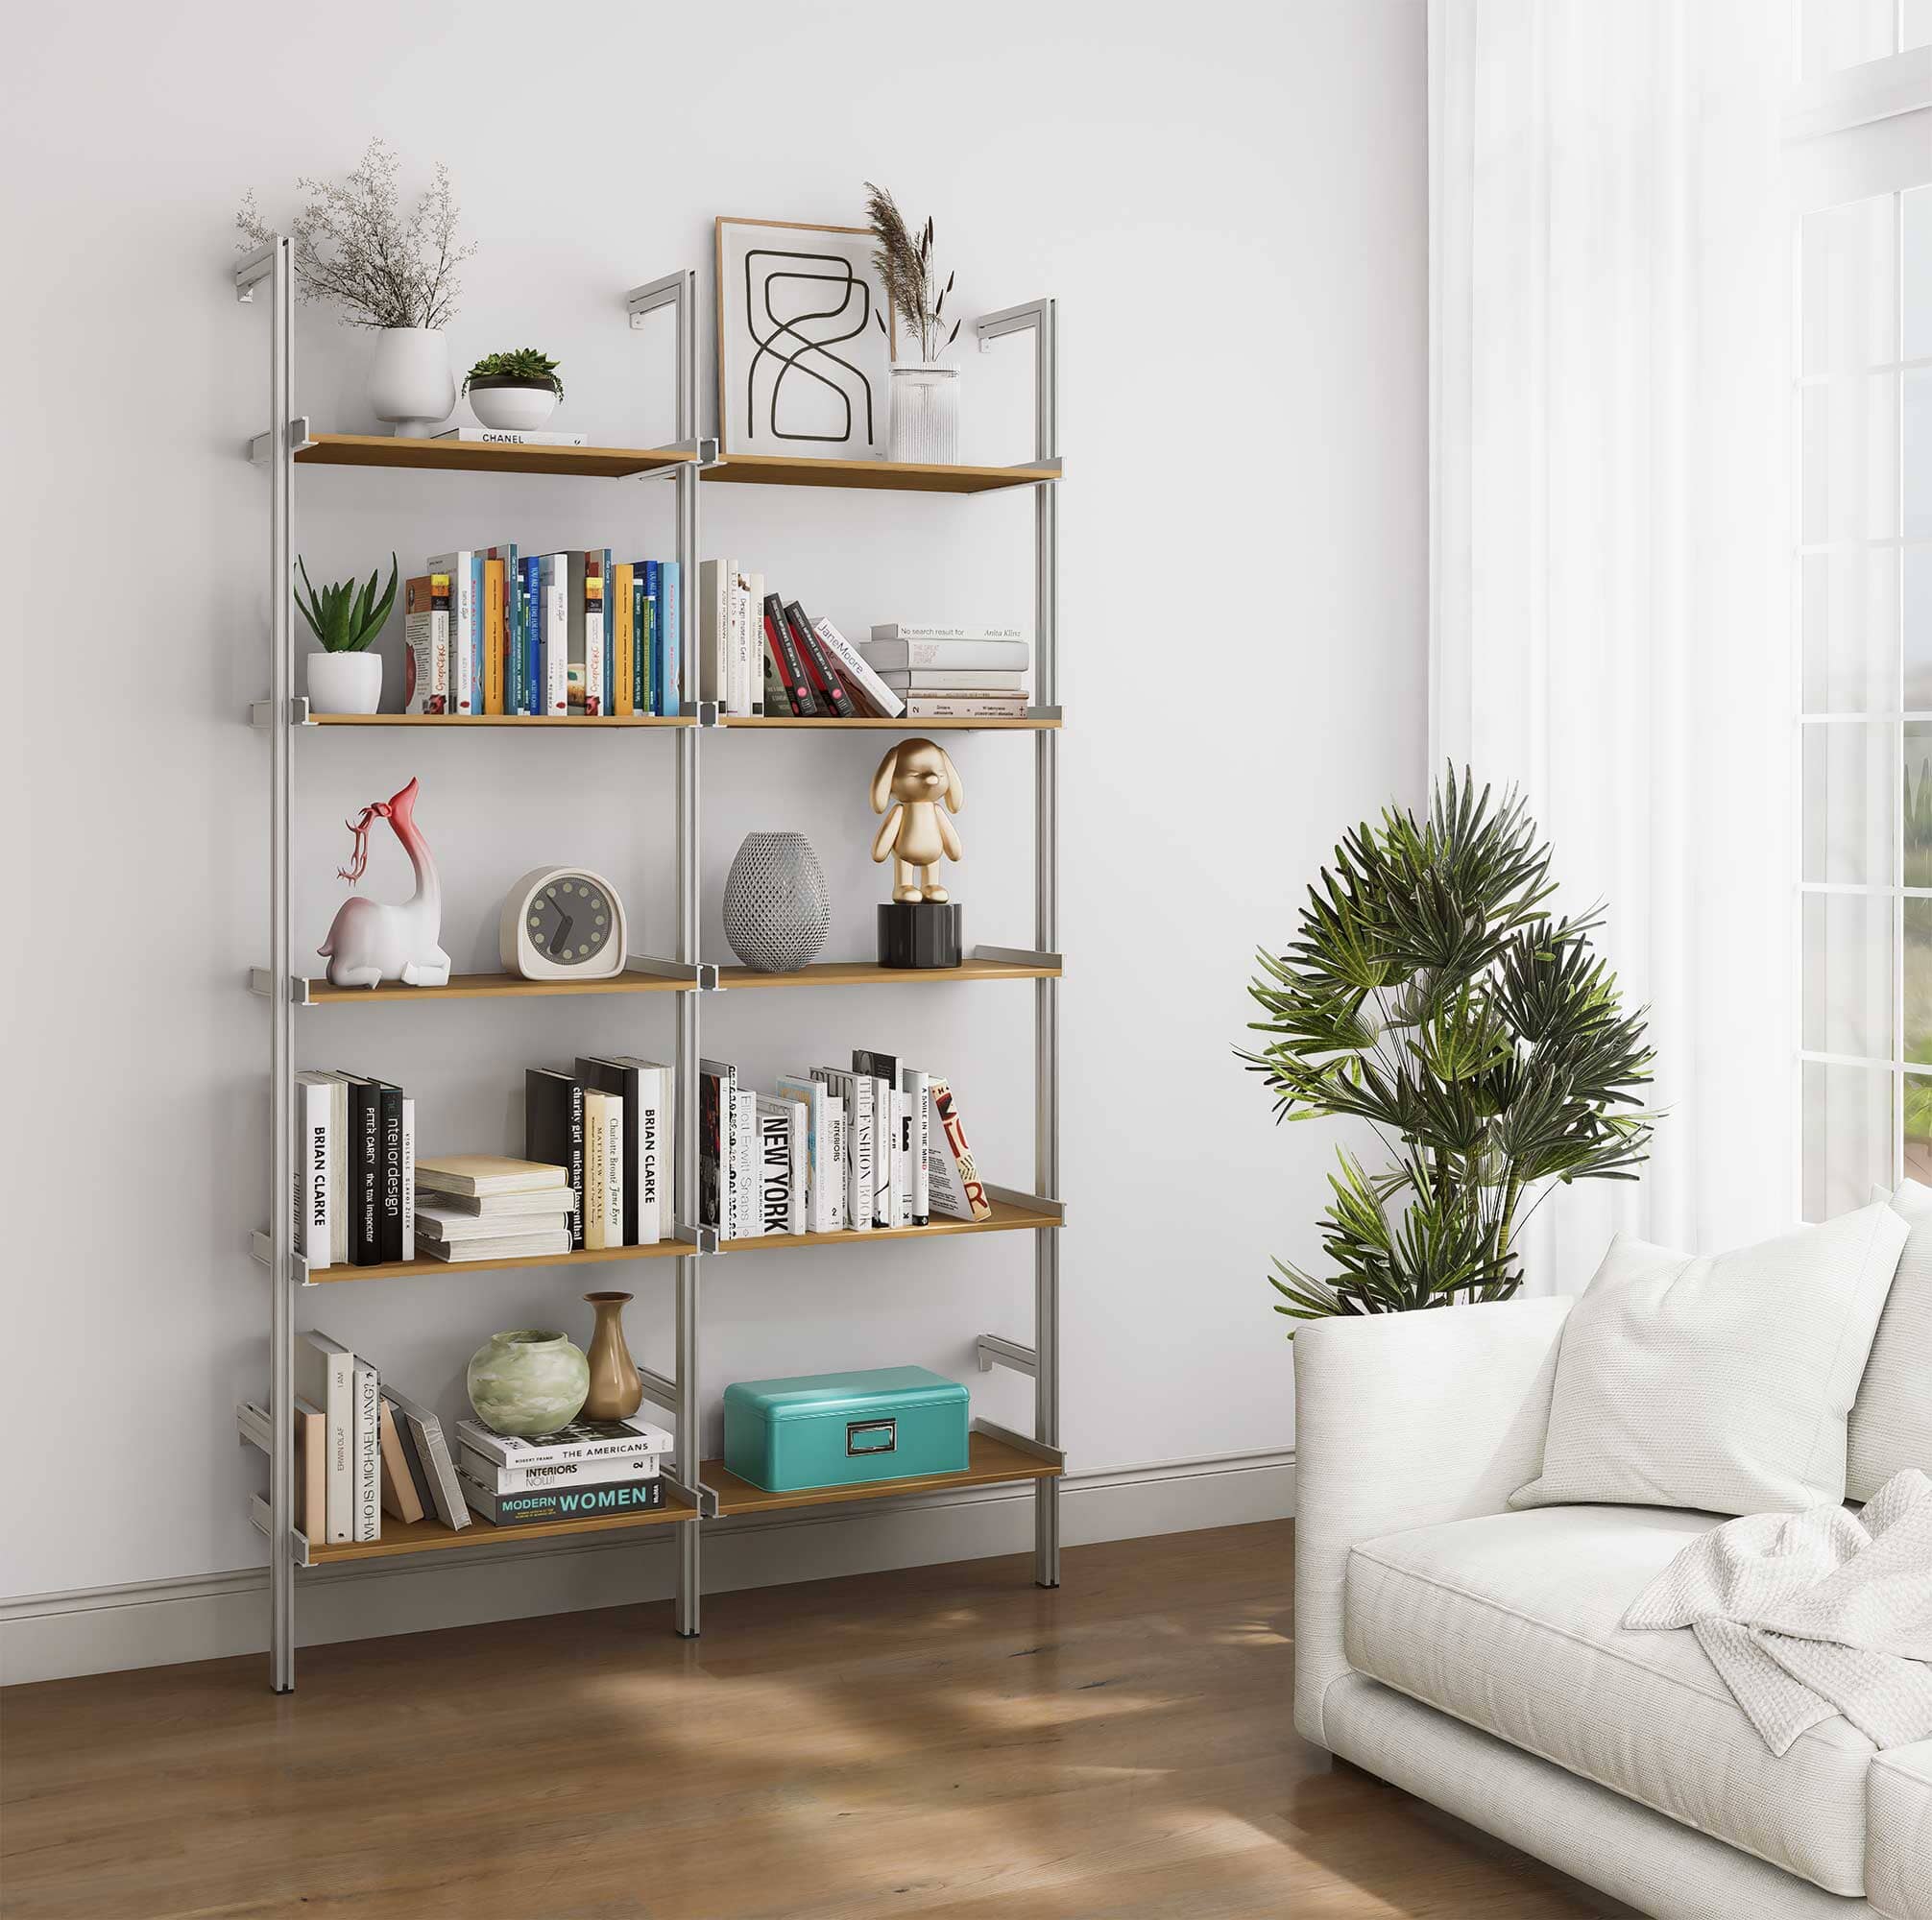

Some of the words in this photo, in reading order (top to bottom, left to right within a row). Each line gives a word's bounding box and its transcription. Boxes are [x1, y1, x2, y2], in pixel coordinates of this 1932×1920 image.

[482, 434, 523, 444] CHANEL
[571, 1087, 582, 1121] charity
[858, 1078, 871, 1112] THE
[366, 1108, 376, 1133] PETER
[571, 1125, 582, 1142] girl
[610, 1118, 618, 1155] Charlotte
[645, 1109, 655, 1150] BRIAN
[922, 1121, 928, 1130] IN
[314, 1128, 326, 1170] BRIAN
[366, 1137, 374, 1164] CAREY
[763, 1118, 788, 1165] NEW
[859, 1115, 871, 1180] FASHION
[366, 1173, 374, 1187] the
[573, 1150, 582, 1188] michael
[645, 1155, 655, 1204] CLARKE
[314, 1175, 326, 1226] CLARKE
[610, 1187, 619, 1206] Jane
[739, 1177, 752, 1221] Snaps
[763, 1172, 788, 1234] YORK
[832, 1208, 837, 1216] 2
[858, 1184, 871, 1227] BOOK
[365, 1205, 374, 1243] inspector
[612, 1208, 620, 1225] Eyre
[337, 1372, 344, 1384] AM
[363, 1383, 375, 1426] JANG?
[363, 1428, 374, 1487] MICHAEL
[587, 1443, 648, 1456] AMERICANS
[526, 1464, 577, 1477] INTERIORS
[363, 1490, 374, 1501] IS
[502, 1497, 556, 1511] MODERN
[559, 1486, 646, 1511] WOMEN
[363, 1505, 374, 1540] WHO
